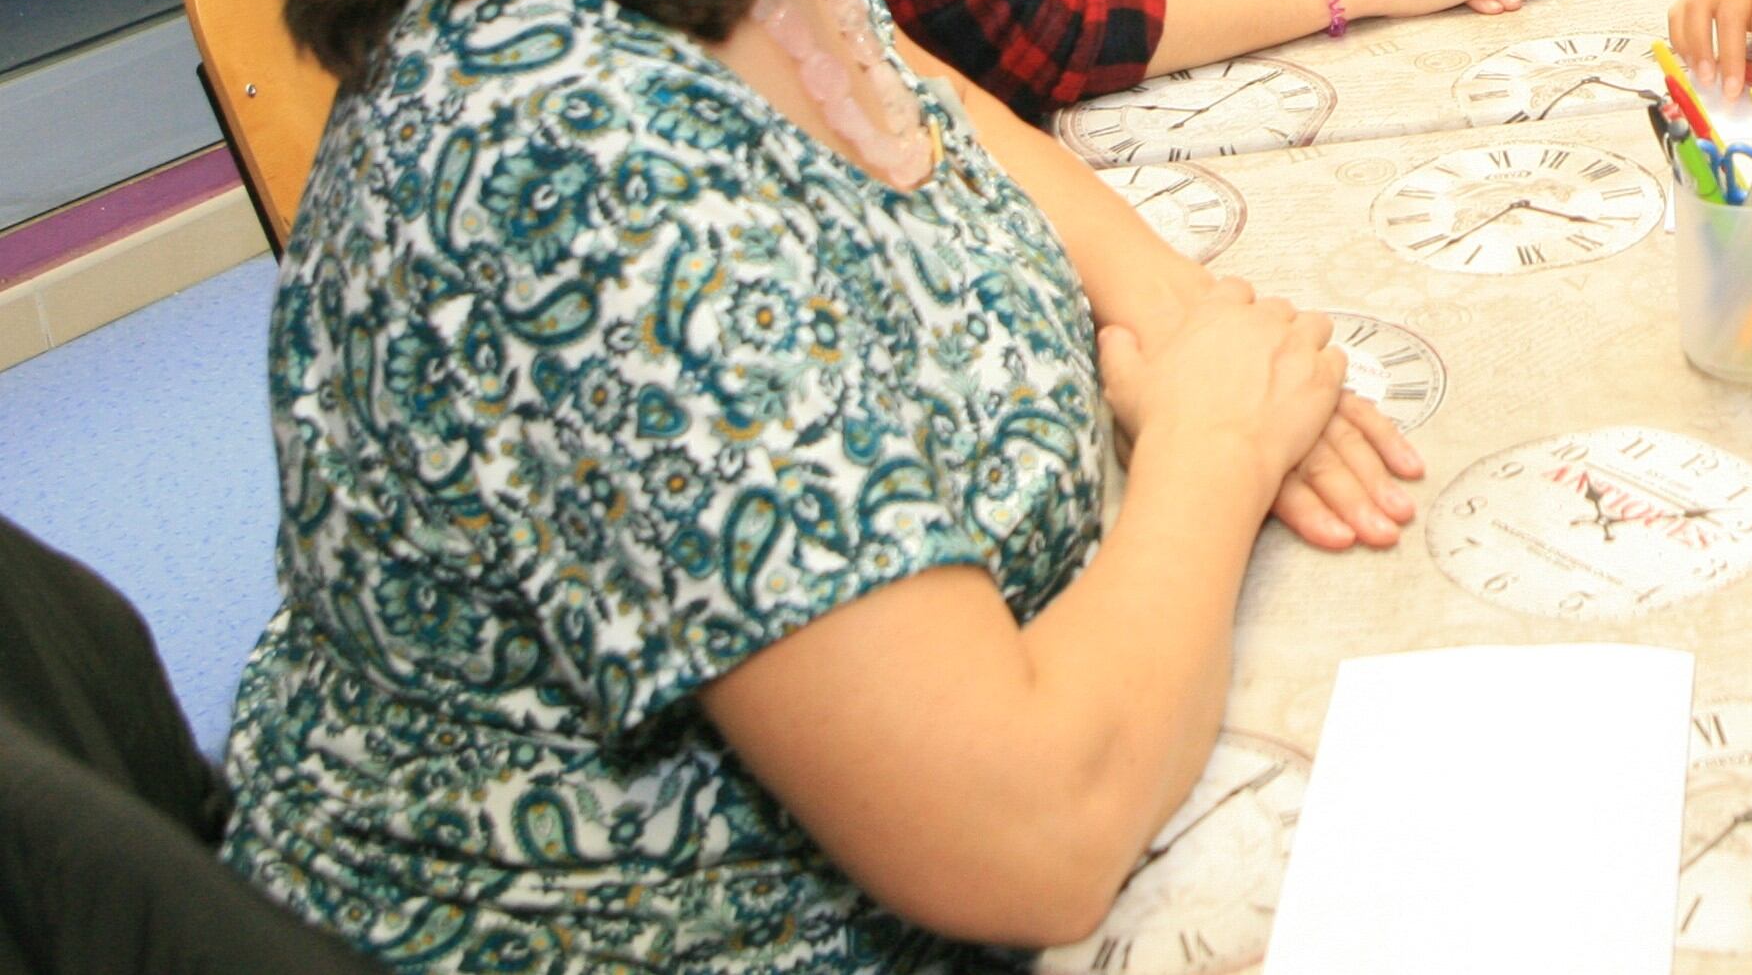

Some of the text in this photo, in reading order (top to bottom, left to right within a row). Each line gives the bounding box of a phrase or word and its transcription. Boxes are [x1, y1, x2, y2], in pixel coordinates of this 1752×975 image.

[1554, 39, 1578, 54] VI
[1487, 150, 1513, 169] VI
[1539, 149, 1571, 170] VII
[1551, 441, 1590, 461] 10
